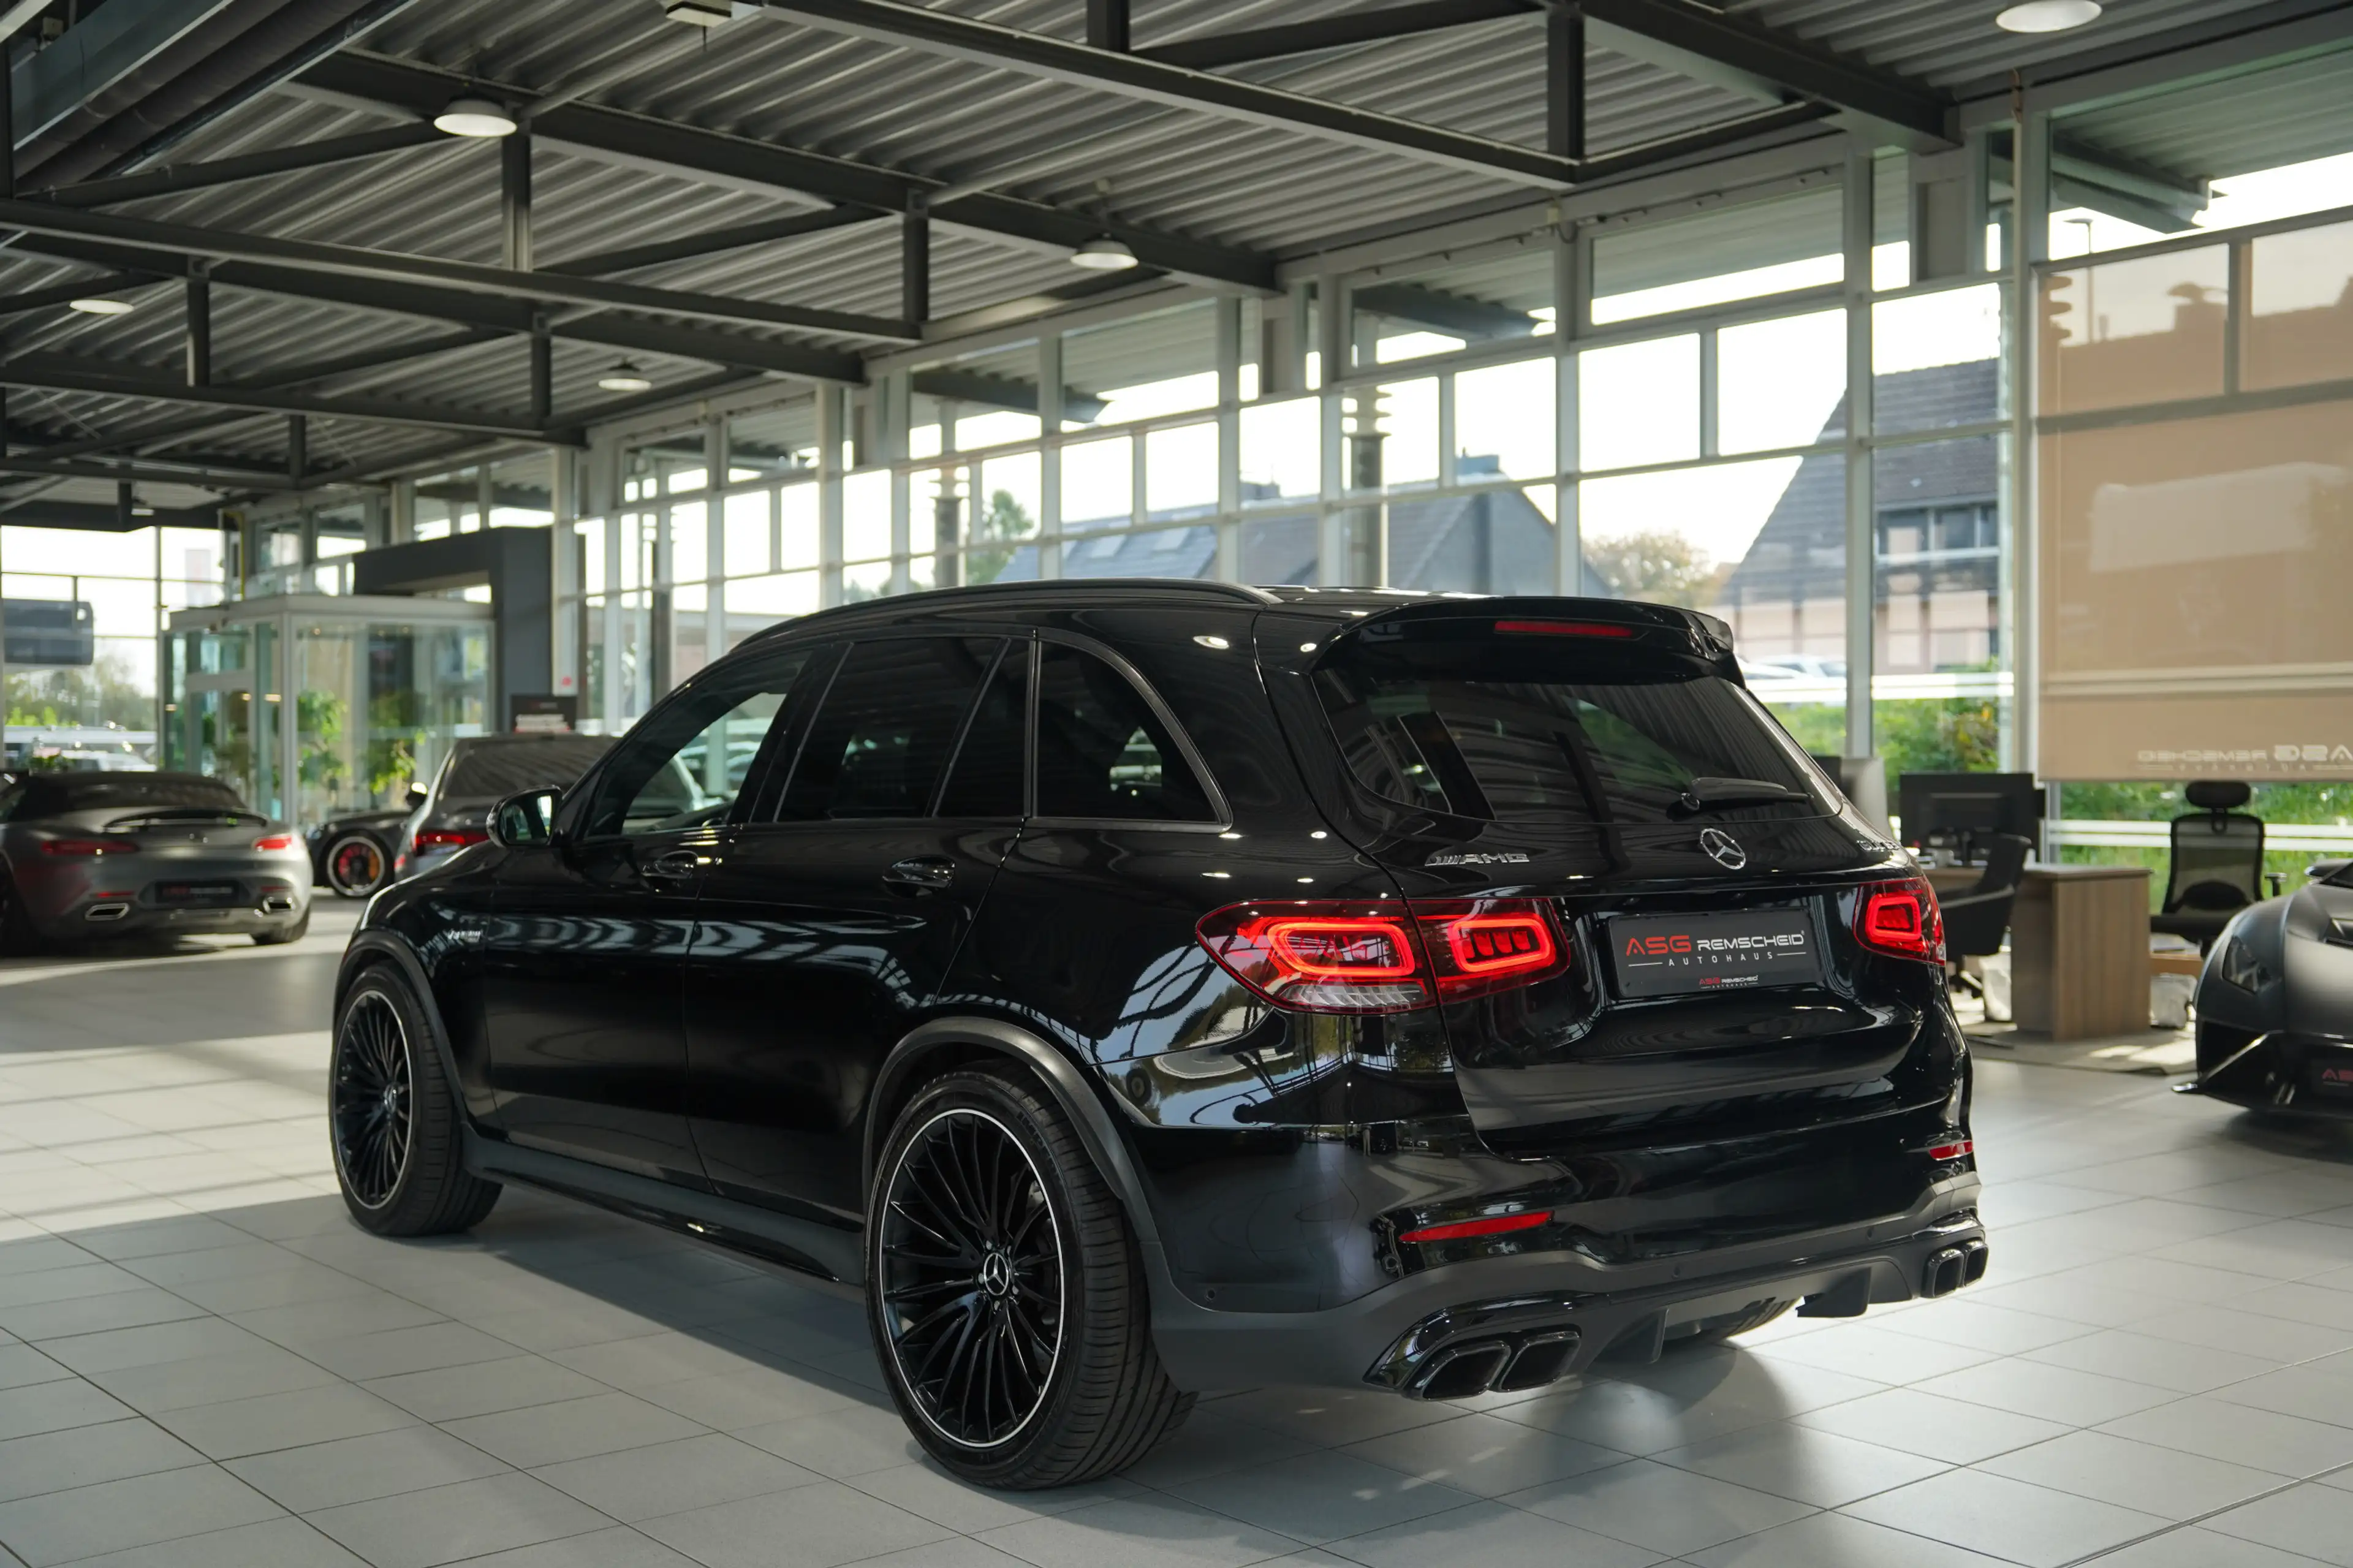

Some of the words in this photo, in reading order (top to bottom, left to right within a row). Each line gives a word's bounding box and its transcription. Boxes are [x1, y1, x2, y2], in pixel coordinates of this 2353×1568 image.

[1459, 852, 1529, 865] AMG
[1626, 935, 1691, 956] ASG
[1669, 951, 1773, 966] AUTOHAUS
